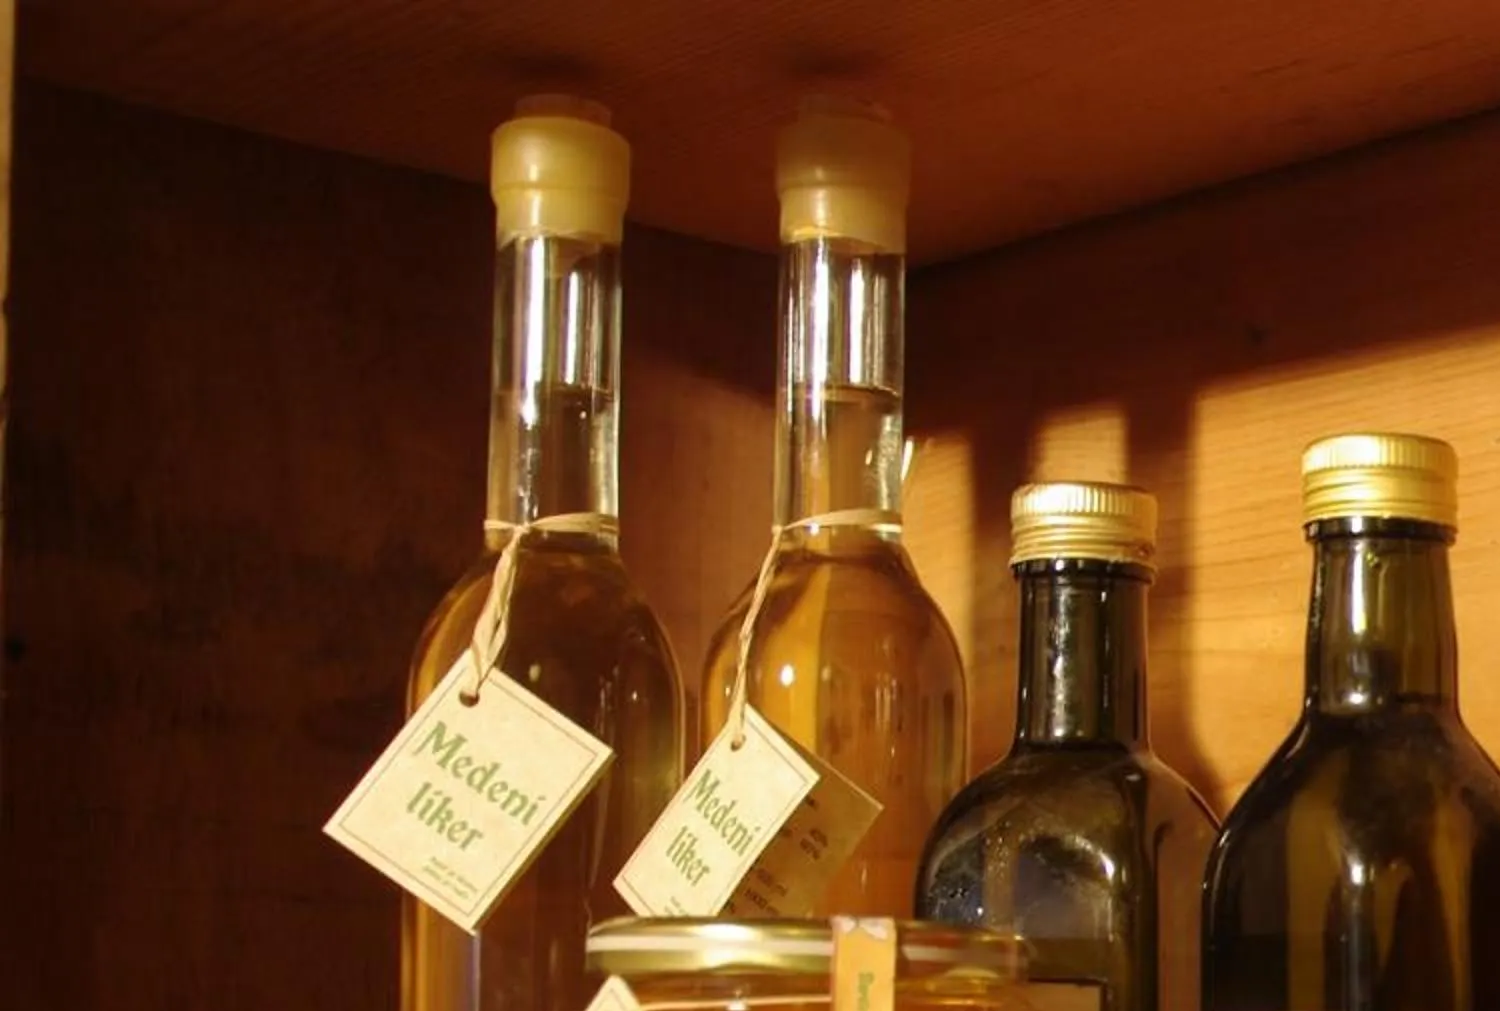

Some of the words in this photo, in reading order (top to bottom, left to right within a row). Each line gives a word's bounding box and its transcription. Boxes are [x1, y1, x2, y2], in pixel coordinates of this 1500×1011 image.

[411, 720, 547, 827] Medeni
[682, 768, 762, 858] Medeni
[406, 781, 484, 852] liker
[665, 824, 712, 887] liker
